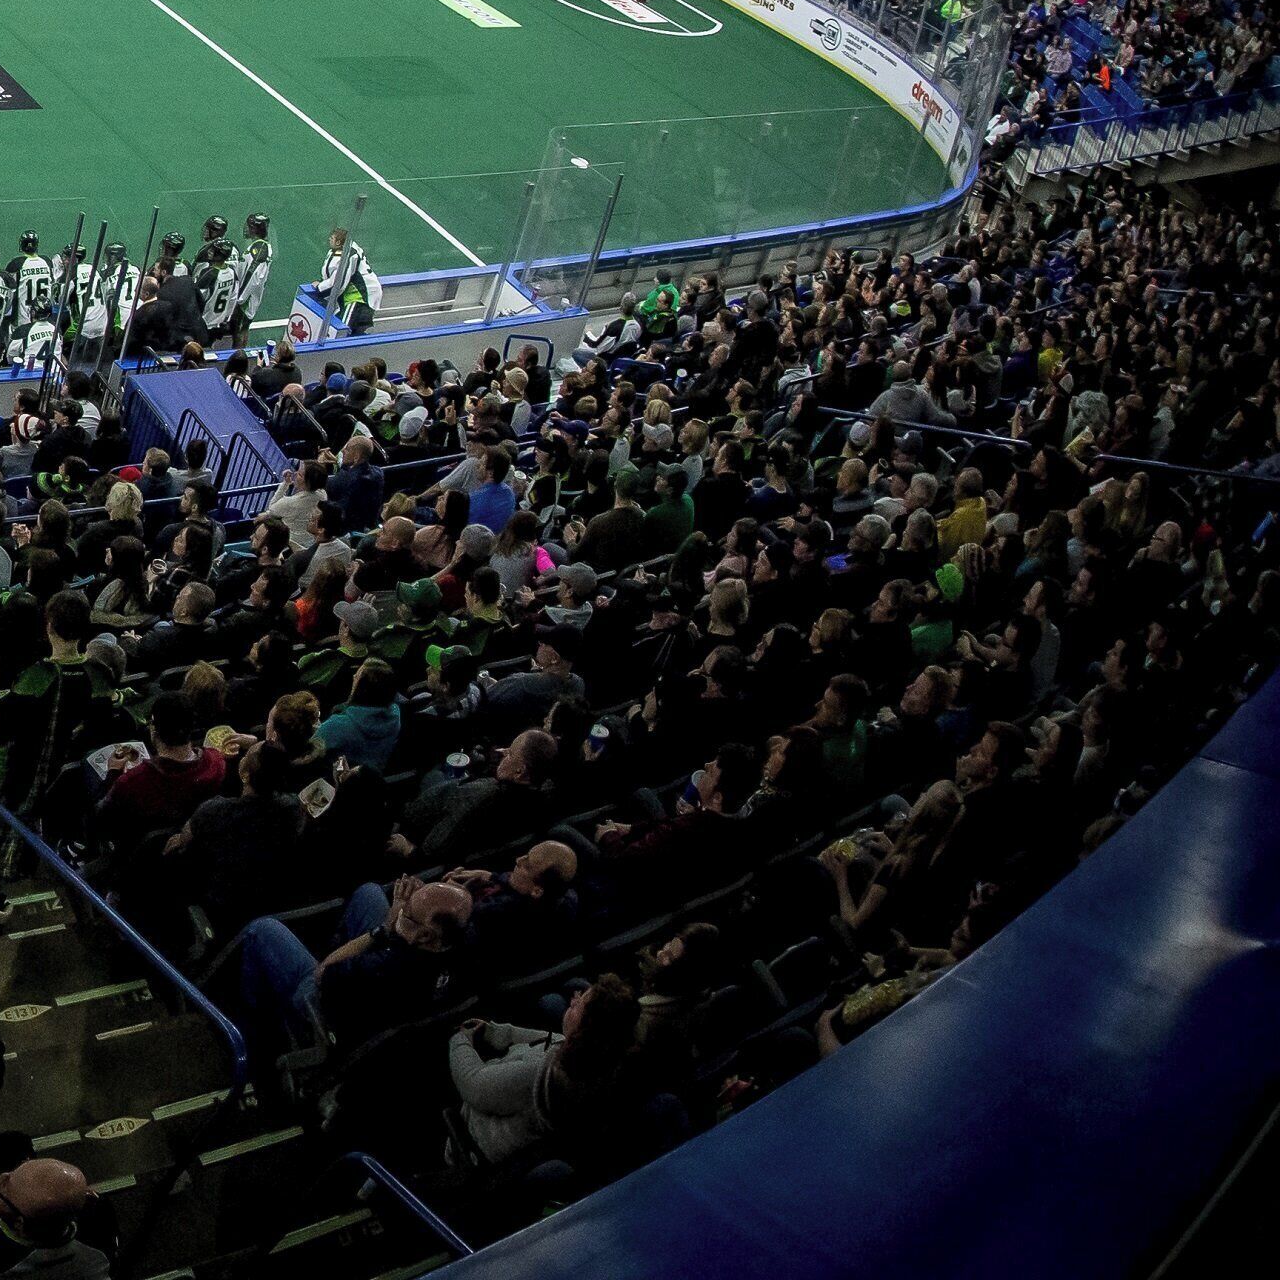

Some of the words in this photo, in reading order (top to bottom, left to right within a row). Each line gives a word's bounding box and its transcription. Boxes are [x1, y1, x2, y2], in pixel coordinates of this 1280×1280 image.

[911, 81, 943, 123] dream
[25, 278, 50, 305] 16
[214, 290, 228, 313] 6
[4, 1010, 12, 1019] E
[15, 1008, 28, 1017] 13
[30, 1006, 38, 1014] D
[98, 1126, 106, 1137] E
[111, 1123, 124, 1134] 14
[127, 1120, 135, 1130] D
